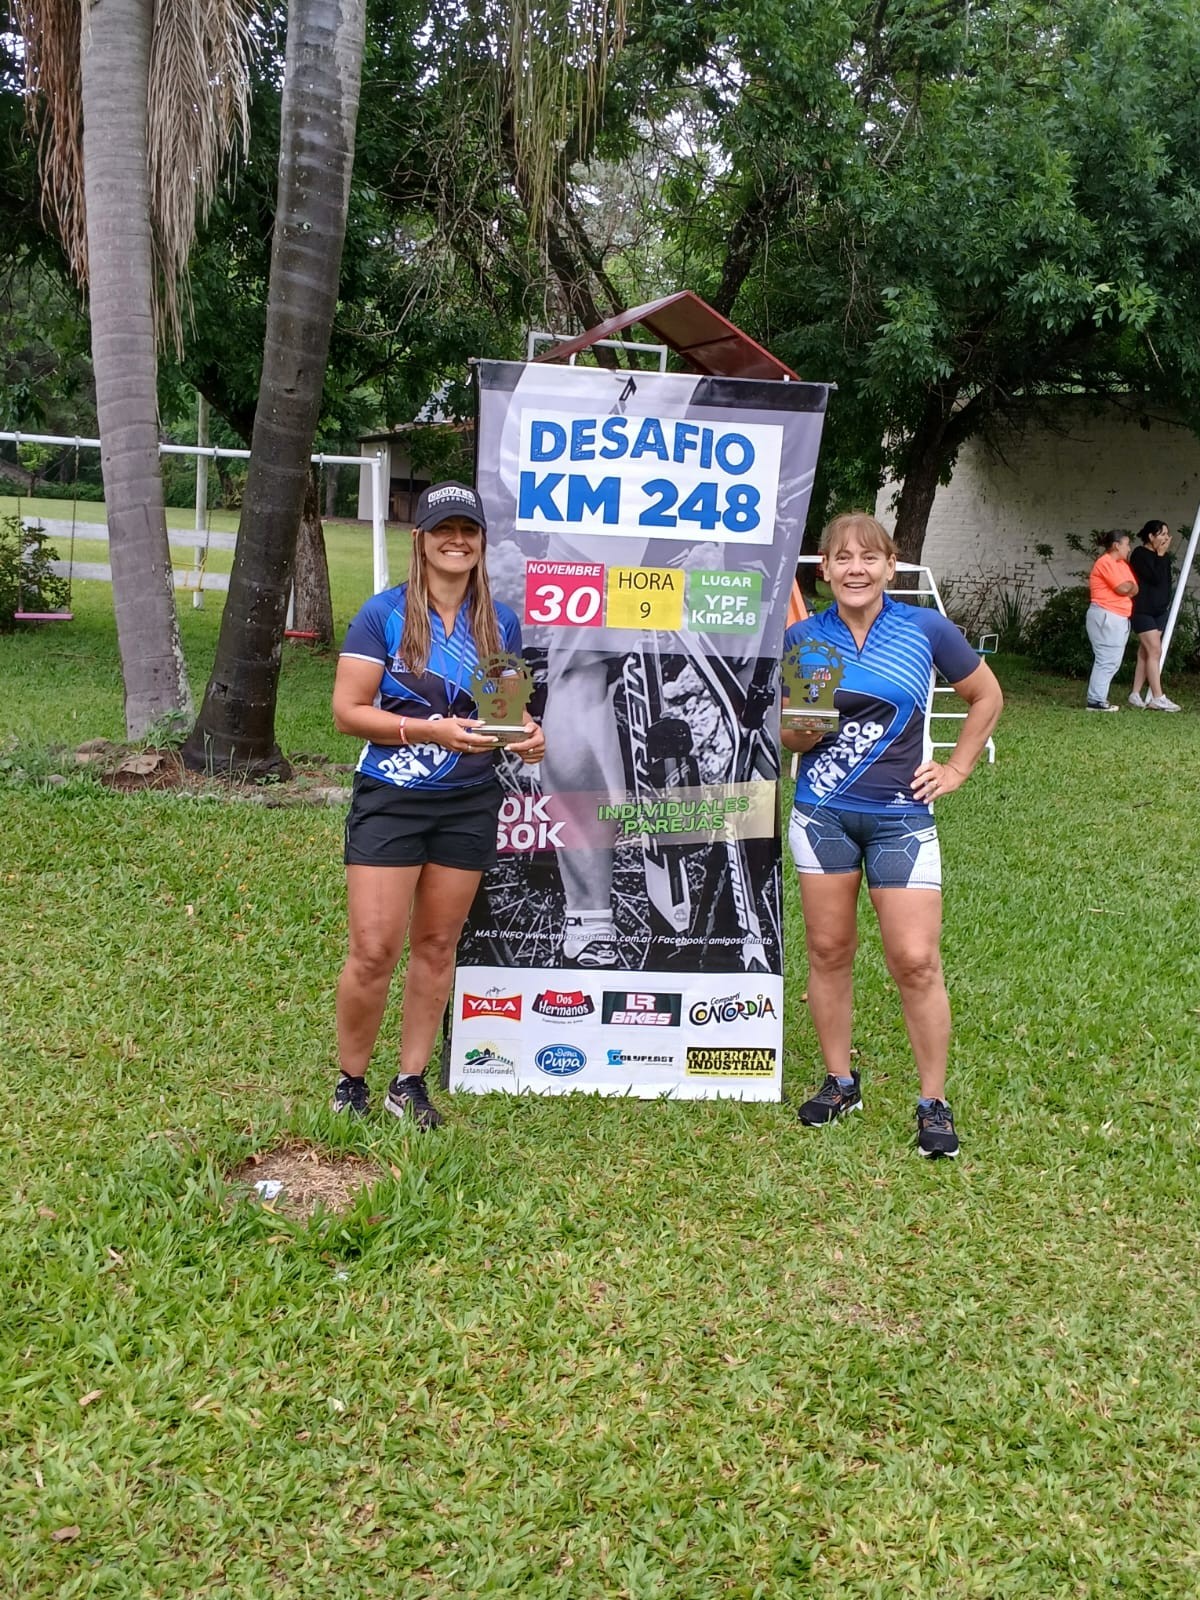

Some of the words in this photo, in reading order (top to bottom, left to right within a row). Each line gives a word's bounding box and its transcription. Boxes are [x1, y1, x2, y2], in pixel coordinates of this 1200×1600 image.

[530, 416, 755, 475] DESAFIO
[518, 471, 621, 524] KM
[639, 478, 761, 533] 248
[527, 563, 601, 577] NOVIEMBRE
[618, 571, 675, 591] HORA
[701, 575, 752, 588] LUGAR
[529, 584, 601, 624] 30
[640, 602, 650, 619] 9
[704, 594, 748, 612] YPF
[691, 610, 756, 626] Km248
[490, 698, 508, 719] 3
[809, 761, 847, 798] KM
[840, 721, 884, 768] 248
[598, 796, 749, 821] INDIVIDUALES
[624, 815, 726, 835] PAREJAS
[475, 929, 498, 938] MAS
[499, 930, 523, 939] INFO
[468, 999, 517, 1012] YALA
[539, 999, 589, 1016] Hermanos
[556, 994, 573, 1005] Dos
[626, 993, 656, 1011] LR
[541, 1051, 581, 1073] Pupa
[688, 1050, 774, 1061] COMERCIAL
[688, 1060, 774, 1071] INDUSTRIAL
